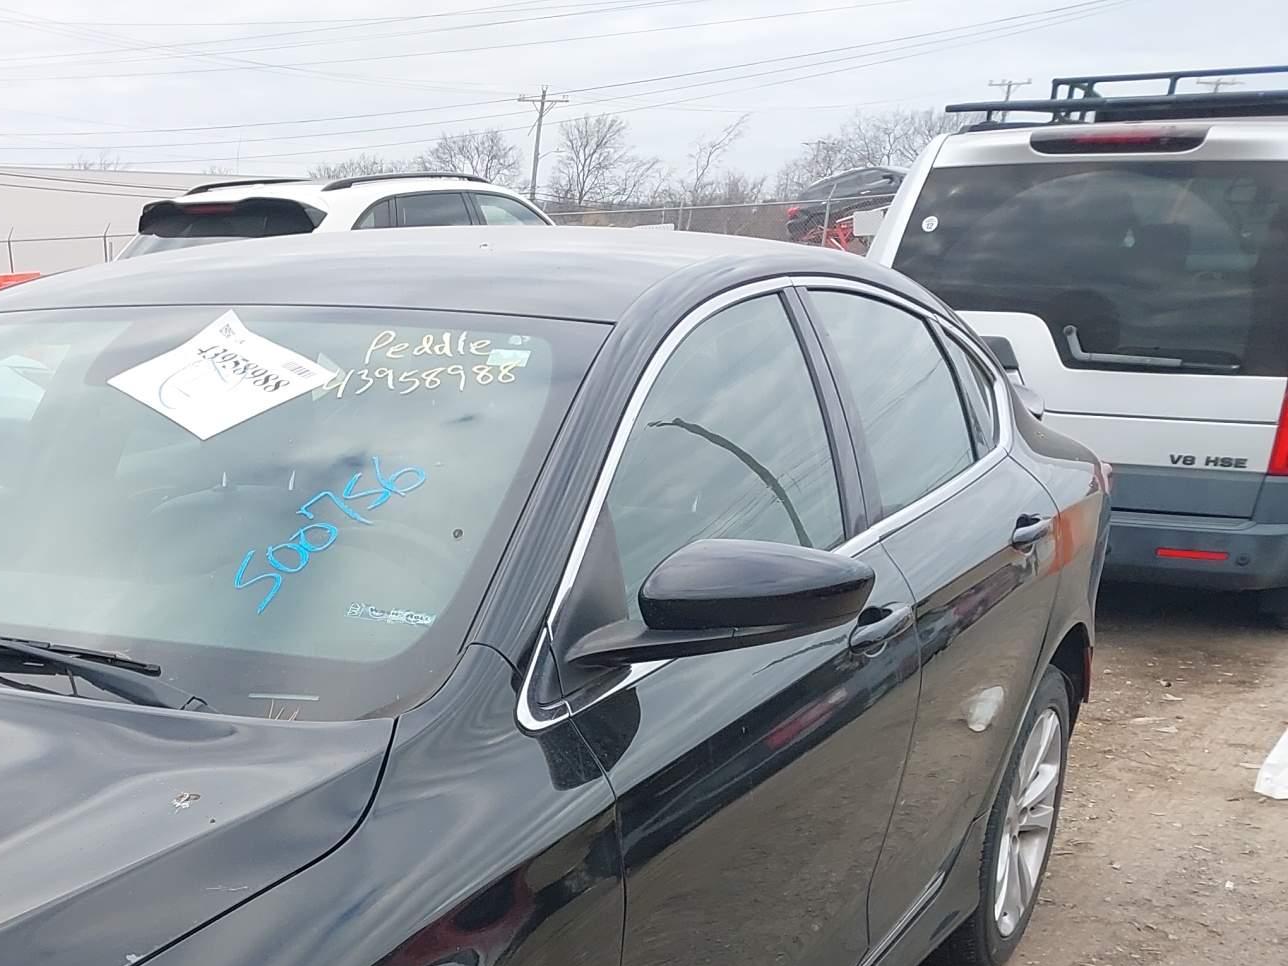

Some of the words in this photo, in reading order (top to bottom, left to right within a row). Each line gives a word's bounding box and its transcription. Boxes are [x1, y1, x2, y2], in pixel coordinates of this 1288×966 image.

[364, 330, 491, 364] Peddle
[197, 345, 290, 392] 43958988
[322, 363, 517, 398] 43958988
[1169, 454, 1196, 466] V8
[1204, 456, 1248, 469] HSE
